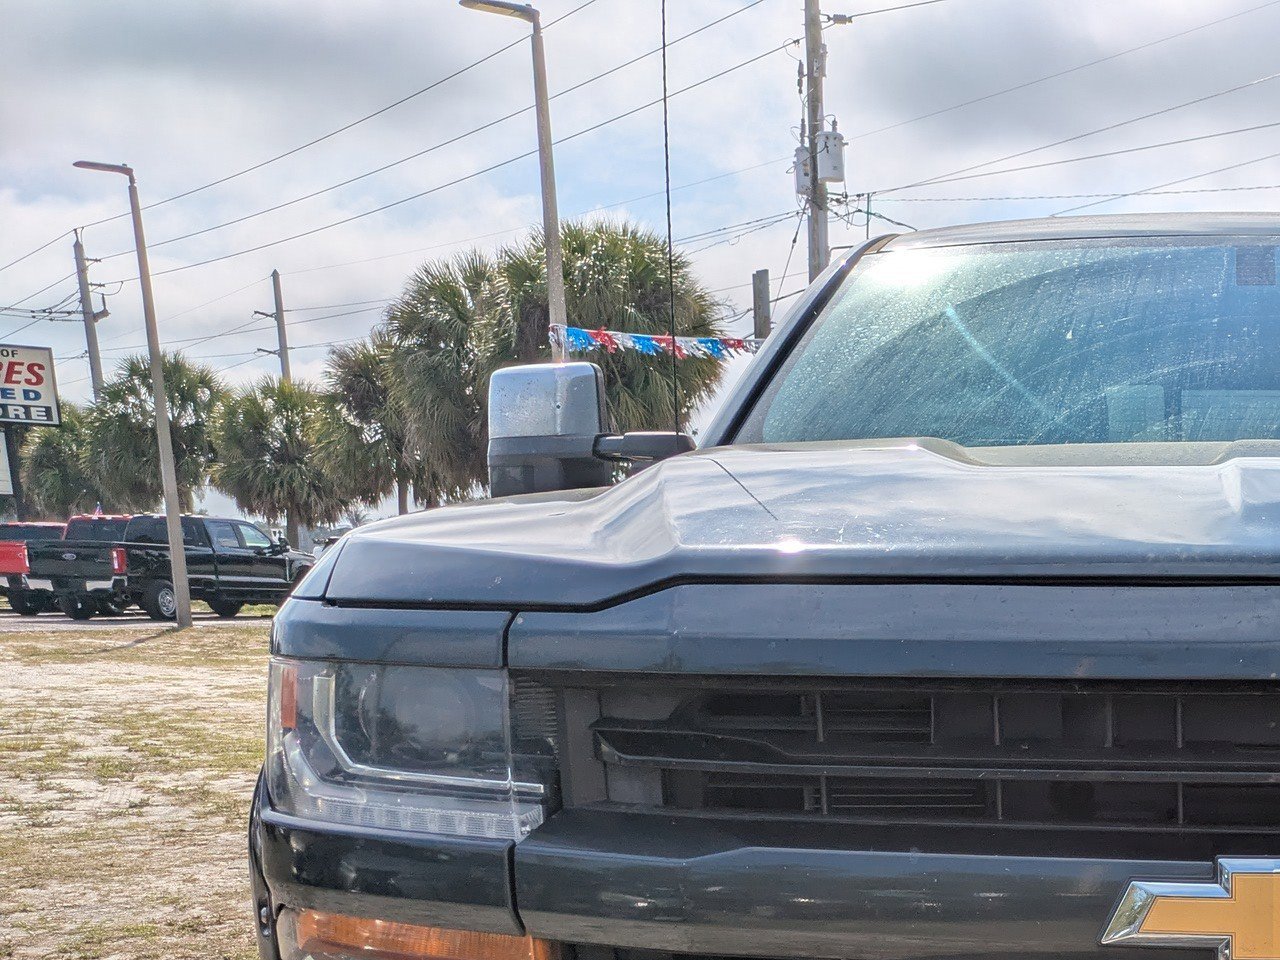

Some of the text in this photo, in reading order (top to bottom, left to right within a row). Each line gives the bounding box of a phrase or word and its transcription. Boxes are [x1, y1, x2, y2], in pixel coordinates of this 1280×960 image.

[1, 349, 18, 357] OF
[0, 361, 45, 386] ES
[0, 406, 47, 420] RE
